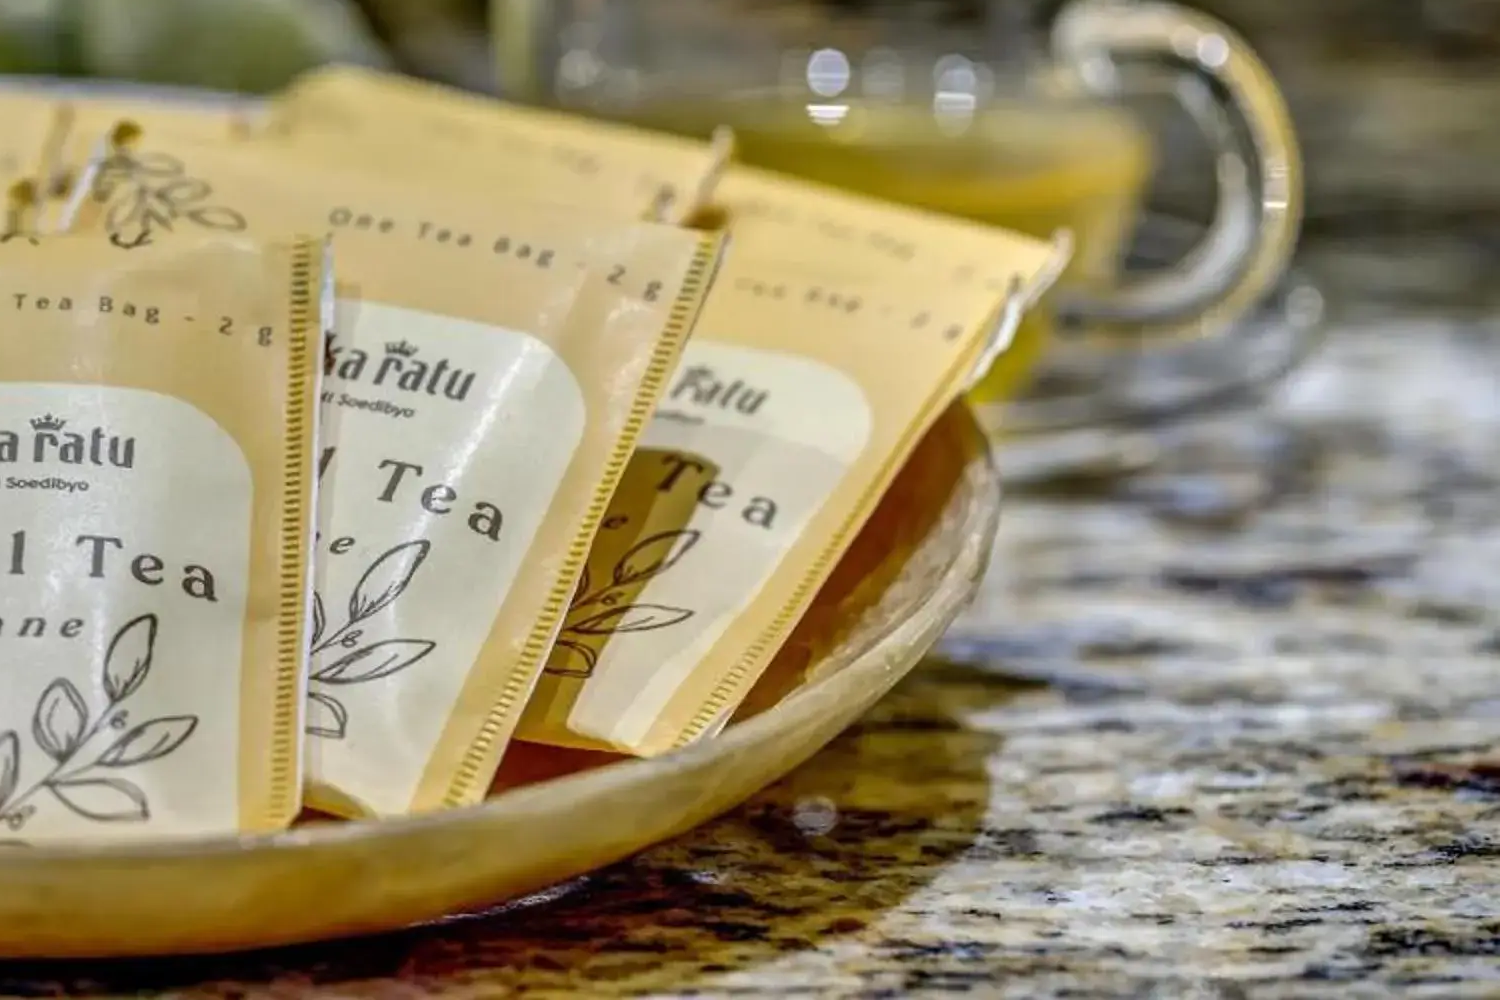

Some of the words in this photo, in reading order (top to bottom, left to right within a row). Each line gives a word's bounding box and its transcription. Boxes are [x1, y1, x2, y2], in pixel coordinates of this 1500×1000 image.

[326, 207, 395, 233] One
[418, 220, 473, 248] Tea
[605, 264, 627, 286] 2
[12, 293, 73, 311] Tea
[98, 295, 161, 325] Bag
[218, 316, 235, 336] 2
[256, 324, 274, 347] g
[33, 426, 136, 469] ratu
[6, 475, 90, 494] Soedibyo
[376, 458, 503, 543] Tea
[656, 452, 778, 530] Tea
[75, 534, 218, 602] Tea
